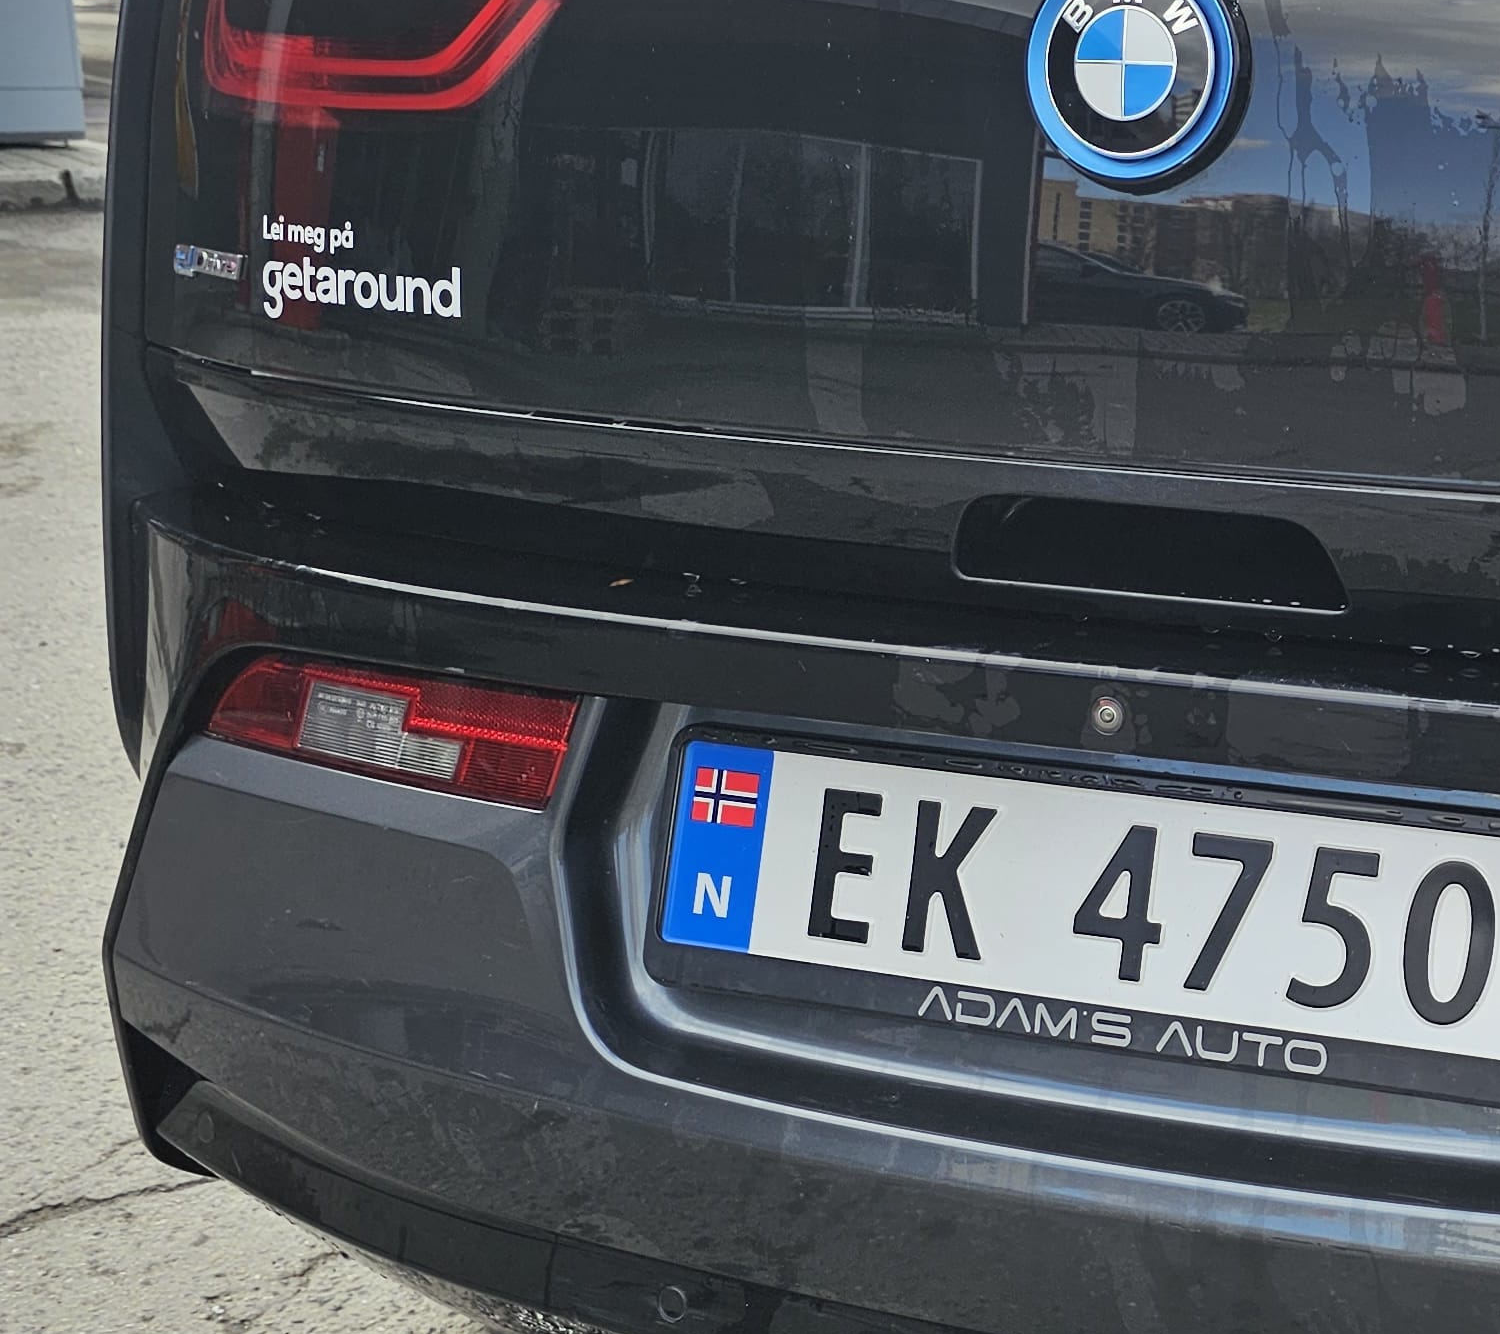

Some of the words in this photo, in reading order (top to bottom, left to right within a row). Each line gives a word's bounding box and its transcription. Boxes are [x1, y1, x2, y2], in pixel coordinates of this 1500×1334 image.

[263, 215, 284, 241] Lei
[287, 224, 325, 253] meg
[329, 221, 354, 254] på
[262, 257, 462, 318] getaround
[692, 872, 732, 918] N
[807, 787, 998, 961] EK
[917, 985, 1132, 1048] ADAM'S
[1155, 1020, 1328, 1075] AUTO
